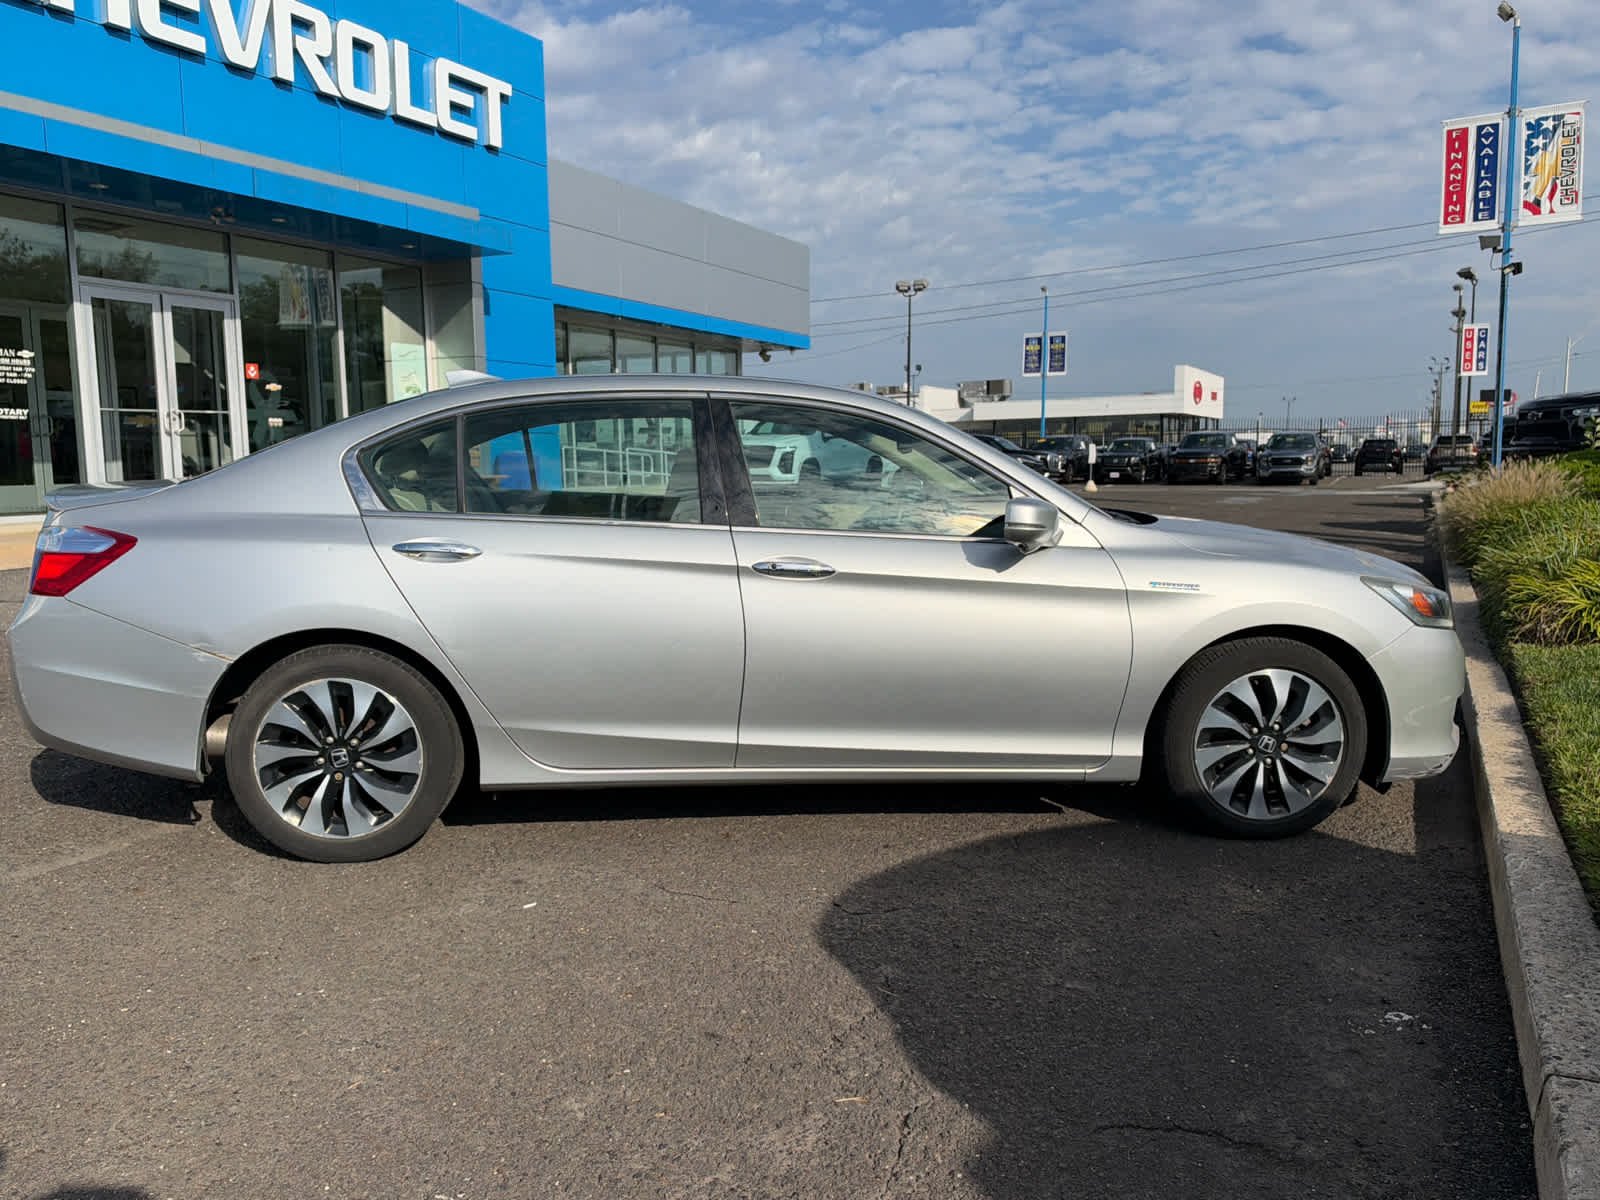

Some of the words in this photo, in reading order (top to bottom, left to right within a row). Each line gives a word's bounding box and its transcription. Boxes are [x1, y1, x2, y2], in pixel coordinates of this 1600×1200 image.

[1447, 130, 1463, 223] FINANCING
[1478, 126, 1494, 220] AVAILABLE
[1560, 120, 1577, 206] CHEVROLET
[1464, 330, 1473, 370] USED
[1478, 330, 1487, 370] CARS
